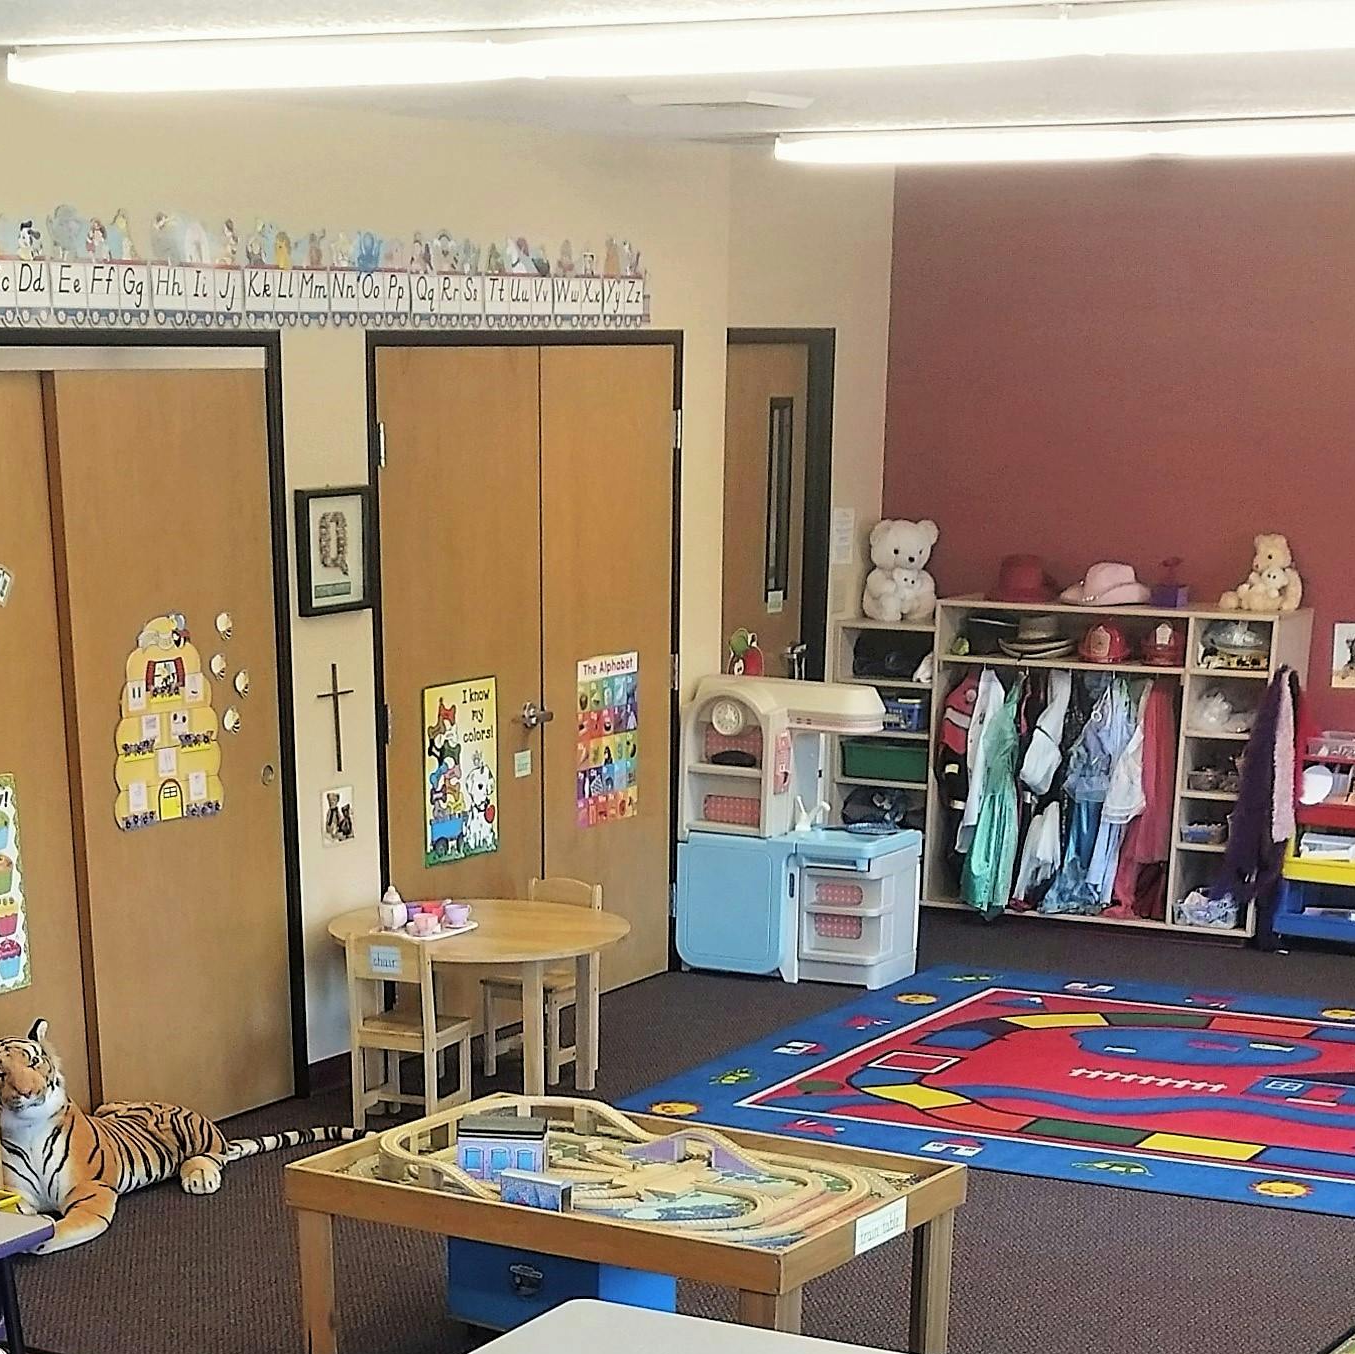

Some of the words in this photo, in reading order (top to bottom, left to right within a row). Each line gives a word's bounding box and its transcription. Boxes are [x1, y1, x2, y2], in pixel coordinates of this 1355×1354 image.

[18, 262, 45, 292] Dd
[58, 264, 82, 294] Ee
[90, 265, 116, 295] Ff
[123, 267, 144, 308] Gg
[156, 267, 183, 297] Hh
[193, 269, 208, 297] Ii
[219, 271, 236, 311] Jj
[248, 275, 272, 298] Kk
[277, 275, 295, 298] Ll
[300, 276, 328, 299] Mm
[332, 276, 355, 299] Nn
[361, 276, 381, 299] Oo
[387, 276, 406, 311] Pp
[416, 276, 436, 313] Qq
[442, 277, 460, 299] Rr
[464, 277, 479, 302] Ss
[489, 278, 505, 303] Tt
[510, 278, 530, 303] Uu
[532, 279, 548, 303] Vv
[555, 279, 579, 303] Ww
[582, 280, 601, 303] Xx
[604, 280, 622, 314] Yy
[625, 281, 642, 304] Zz
[583, 664, 598, 676] The
[599, 658, 633, 675] Alphabet
[462, 689, 468, 704] I
[469, 688, 491, 702] know
[471, 708, 485, 723] my
[463, 725, 494, 743] colors!
